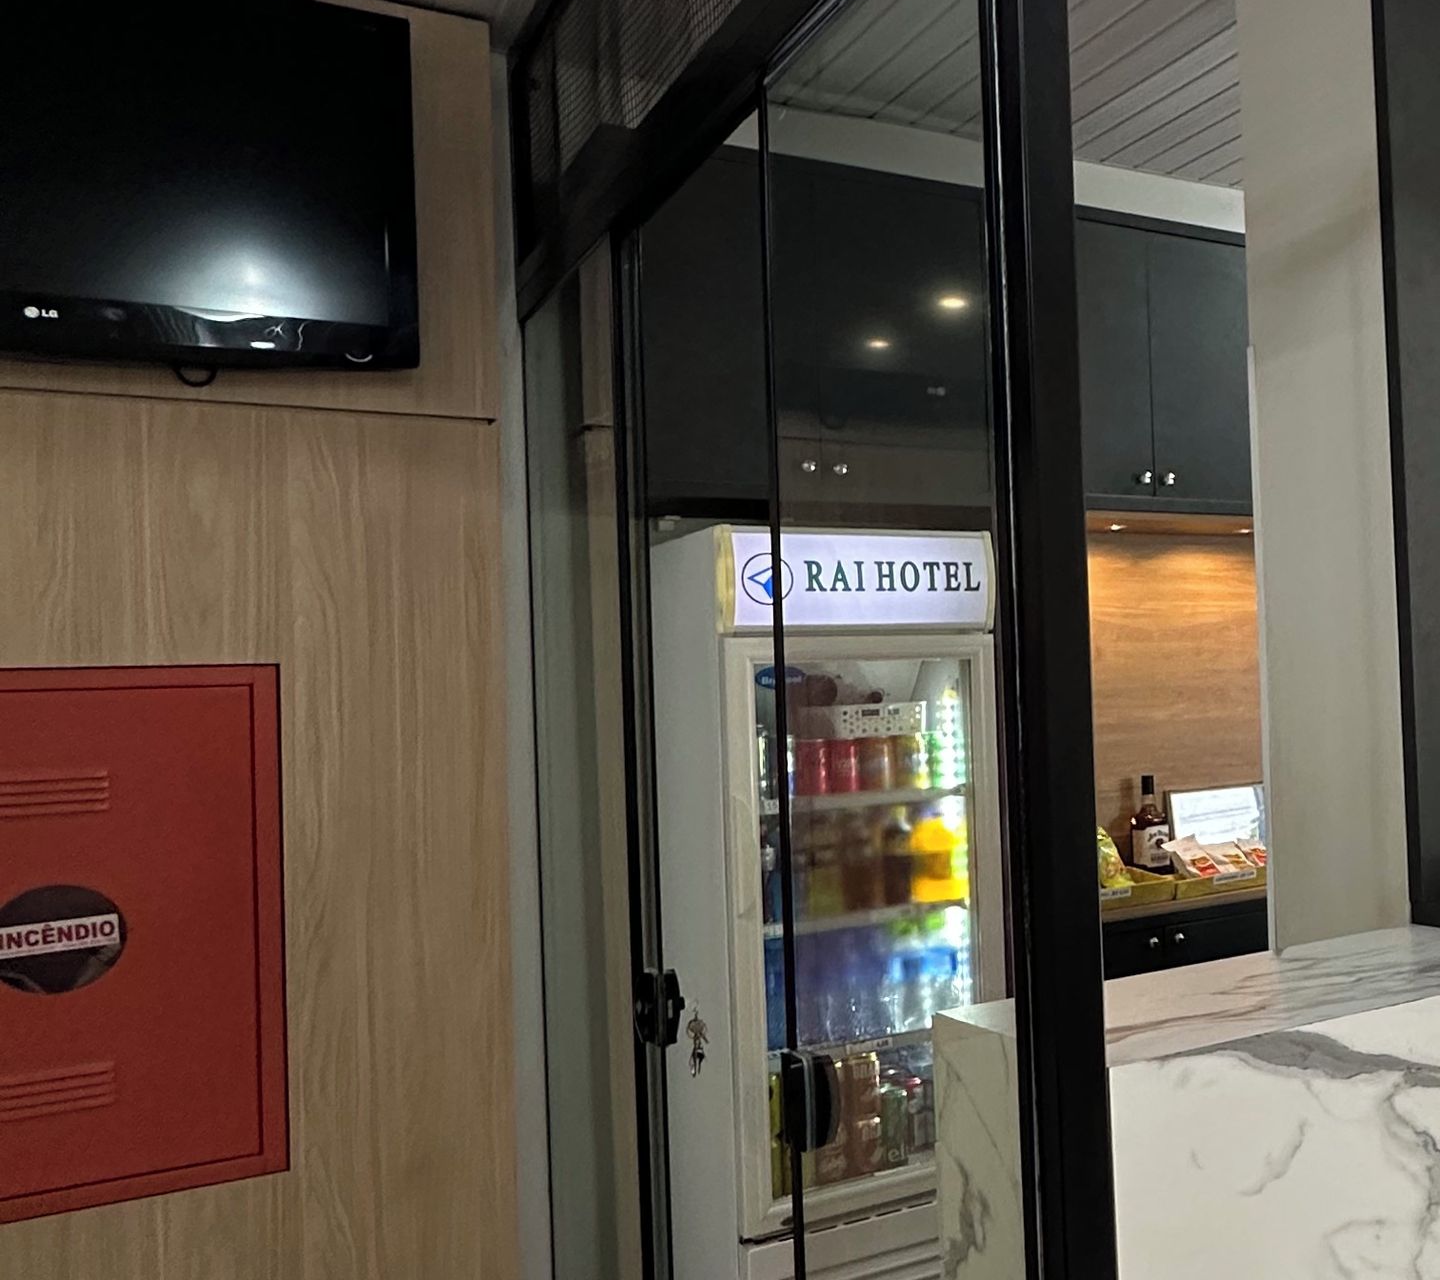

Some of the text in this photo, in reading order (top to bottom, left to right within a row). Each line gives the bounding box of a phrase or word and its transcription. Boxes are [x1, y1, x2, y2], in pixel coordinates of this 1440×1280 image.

[41, 308, 59, 318] LG
[803, 560, 981, 592] RAI HOTEL
[0, 920, 115, 950] INCÊNDIO
